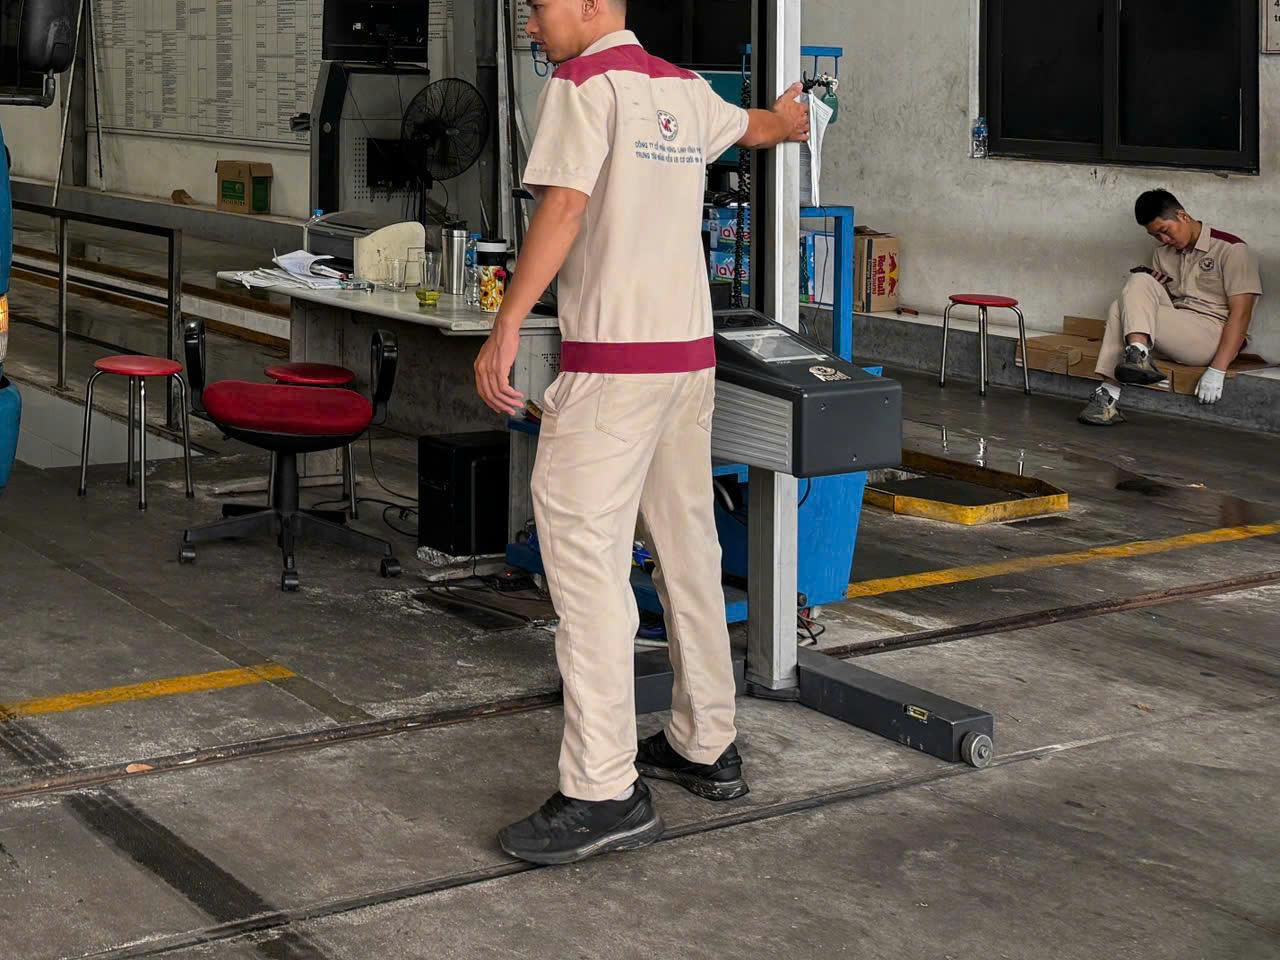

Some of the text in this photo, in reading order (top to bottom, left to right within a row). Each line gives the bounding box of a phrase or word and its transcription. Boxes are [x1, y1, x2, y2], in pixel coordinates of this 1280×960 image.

[720, 225, 752, 239] laVe
[716, 264, 747, 279] laVe
[877, 255, 886, 296] Red Bull
